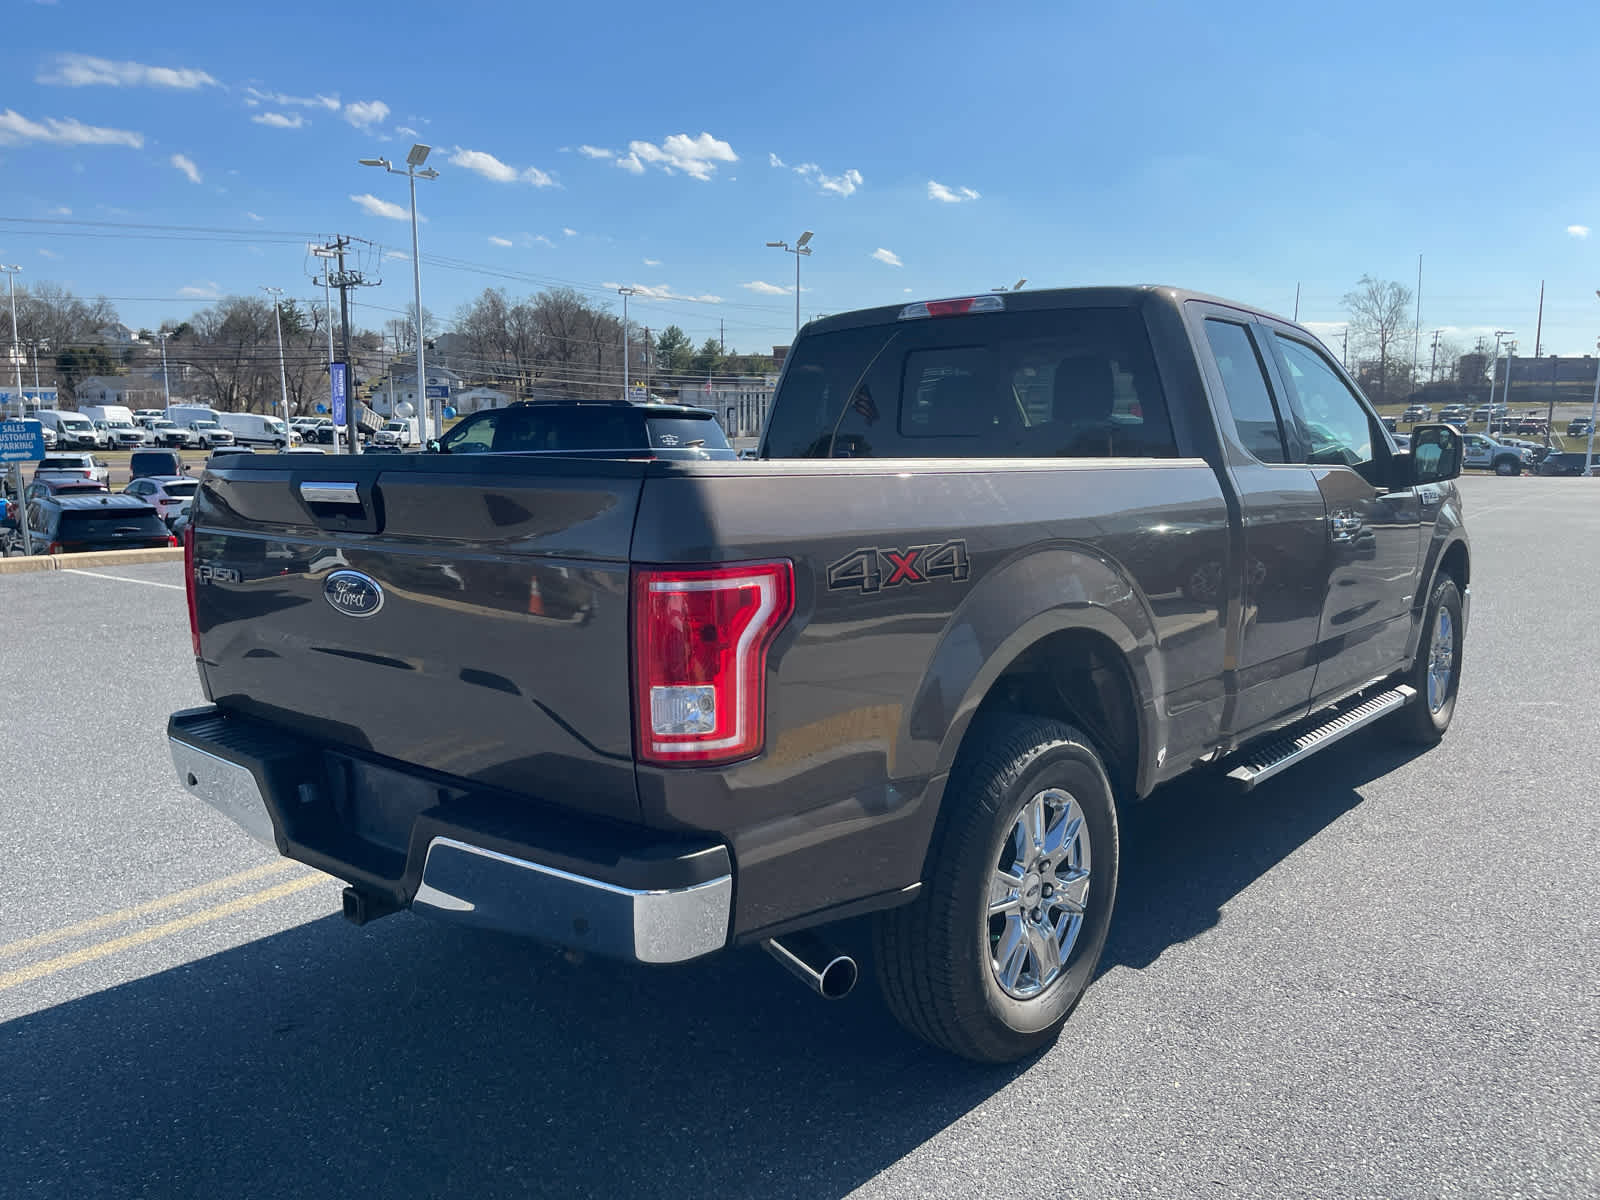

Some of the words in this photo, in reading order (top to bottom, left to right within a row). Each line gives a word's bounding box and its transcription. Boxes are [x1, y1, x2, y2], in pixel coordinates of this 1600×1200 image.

[2, 424, 26, 433] SALES
[0, 432, 36, 441] USTOMER
[0, 441, 34, 450] PARKING
[333, 579, 366, 608] Ford
